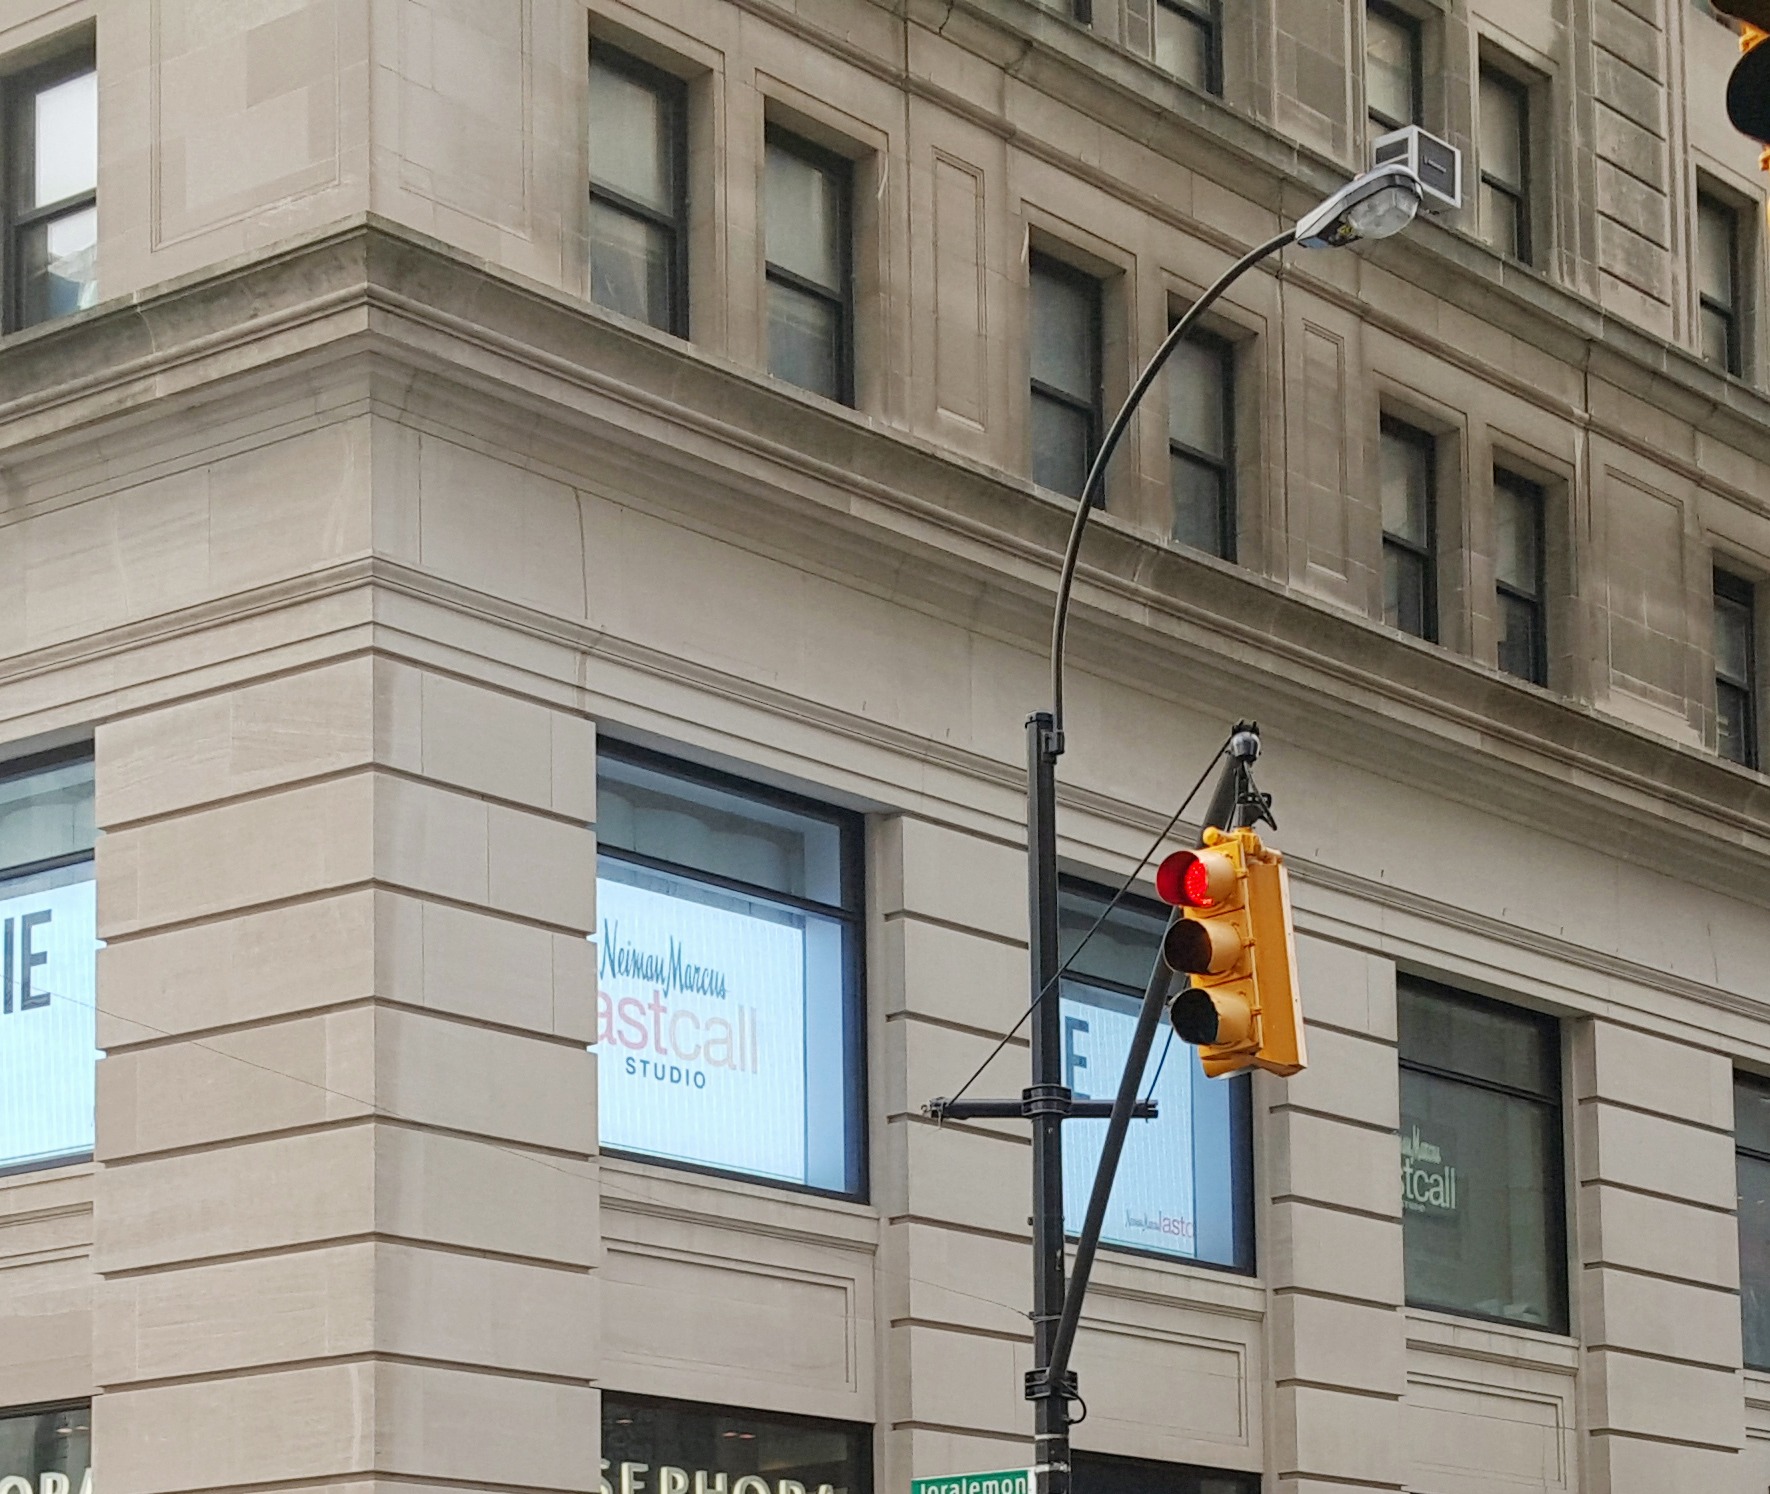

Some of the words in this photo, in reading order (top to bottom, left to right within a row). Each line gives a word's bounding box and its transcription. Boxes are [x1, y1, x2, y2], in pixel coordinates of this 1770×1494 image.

[600, 918, 666, 985] Neiman
[663, 935, 728, 1000] Marcus
[598, 989, 758, 1074] astcall
[625, 1056, 707, 1090] STUDIO
[1403, 1157, 1456, 1209] tcall
